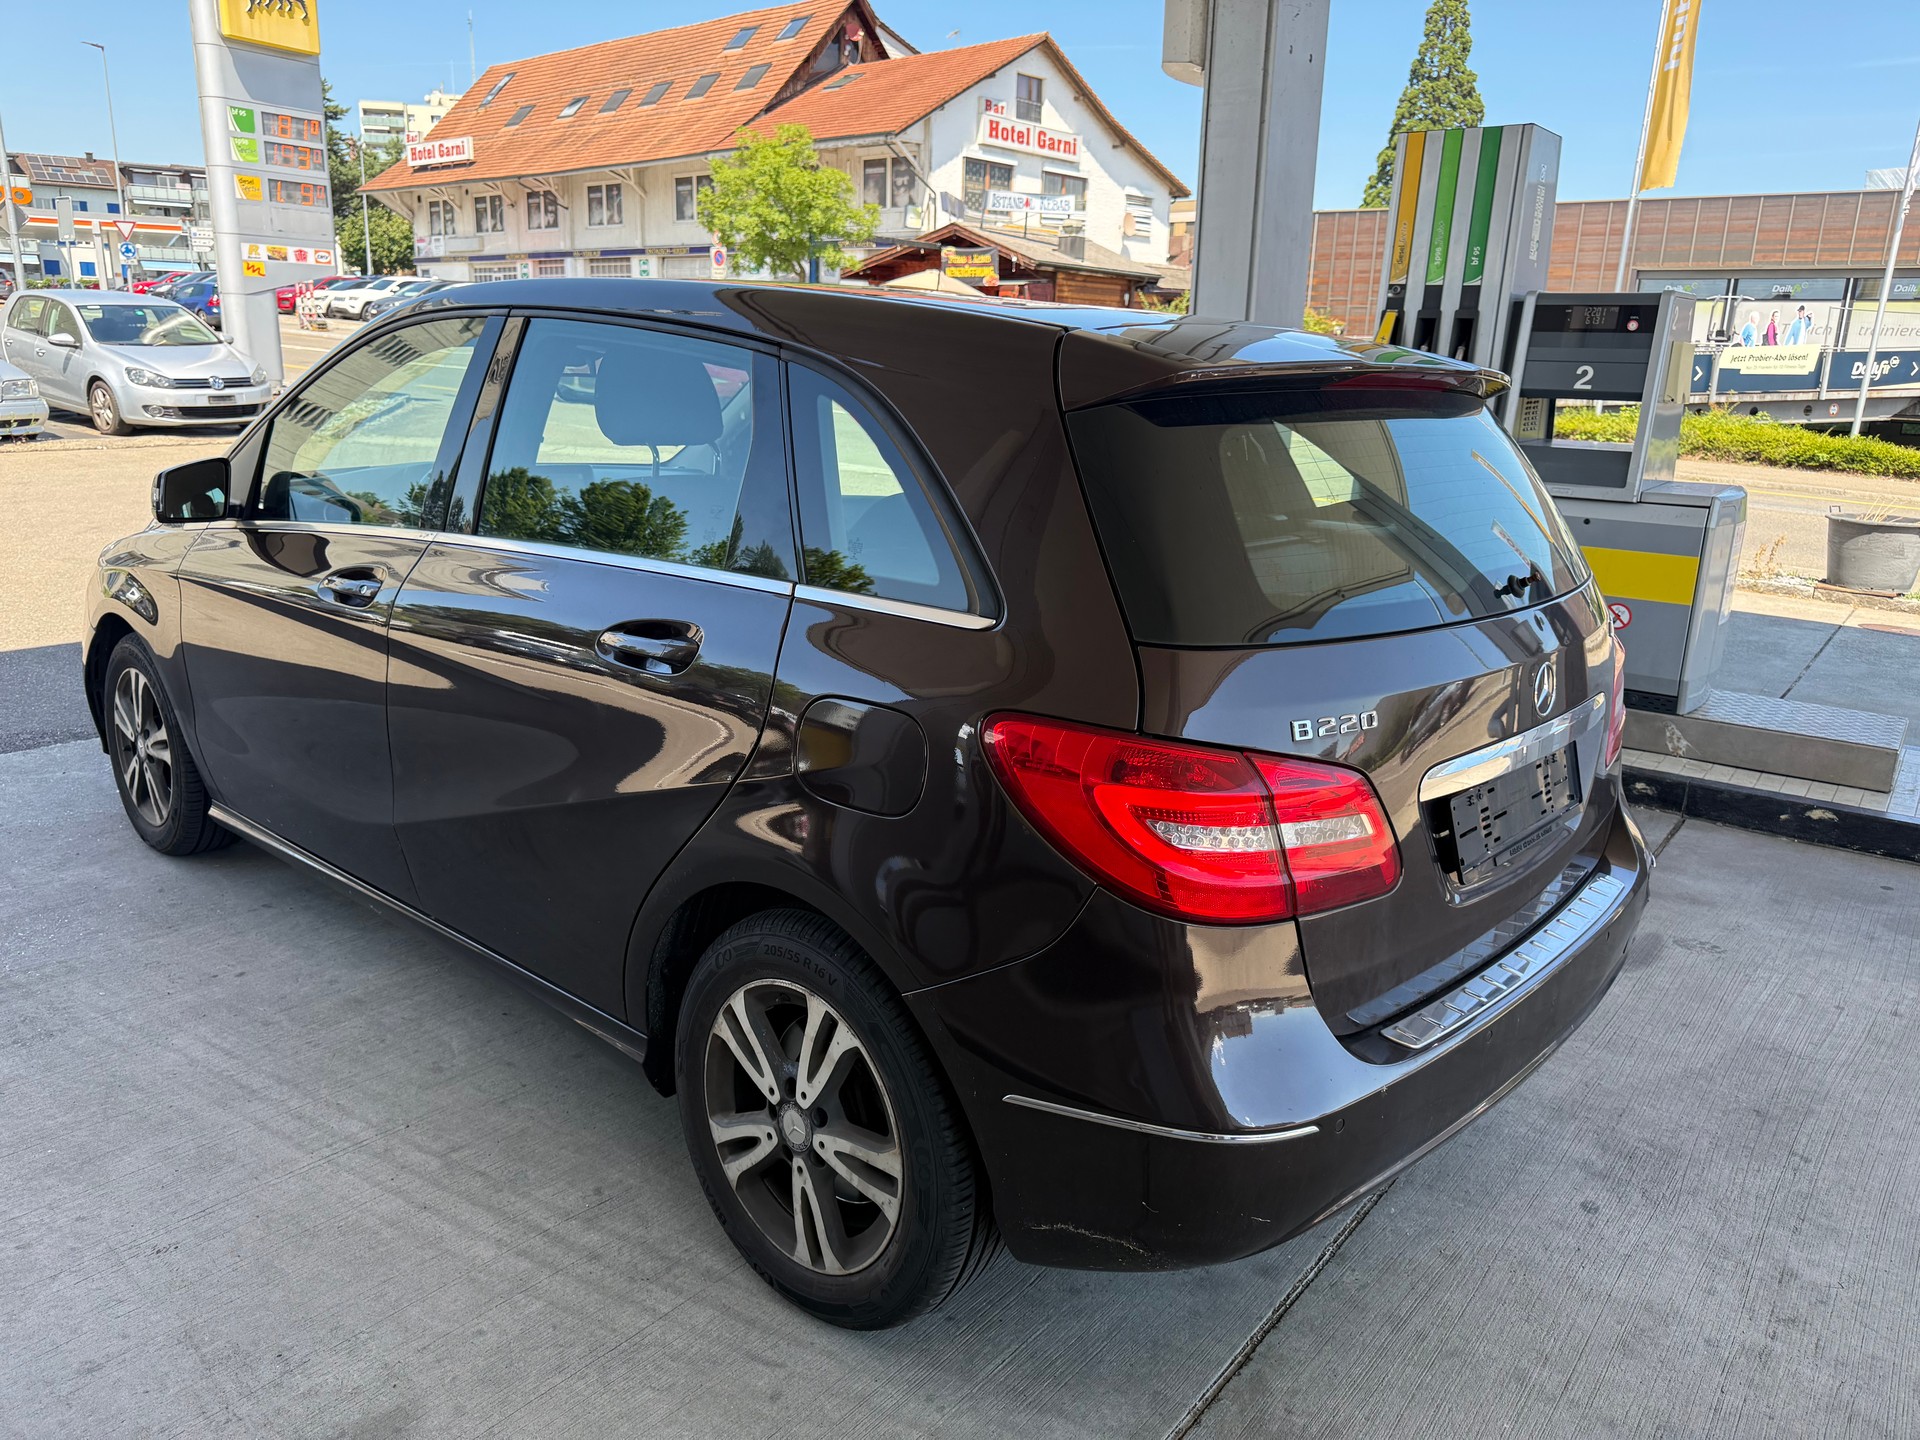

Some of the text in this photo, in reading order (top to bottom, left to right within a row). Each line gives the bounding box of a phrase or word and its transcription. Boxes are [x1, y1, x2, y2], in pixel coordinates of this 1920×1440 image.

[985, 98, 1005, 115] Bar
[988, 119, 1077, 156] Hotel Garni
[410, 140, 466, 161] Hotel Garni
[1470, 246, 1481, 266] bf 95
[1672, 306, 1694, 331] 2 1
[1730, 353, 1809, 364] Jetzt Probier-Abo lösen!
[1573, 365, 1595, 390] 2
[763, 944, 838, 986] 205/55 R 16 V
